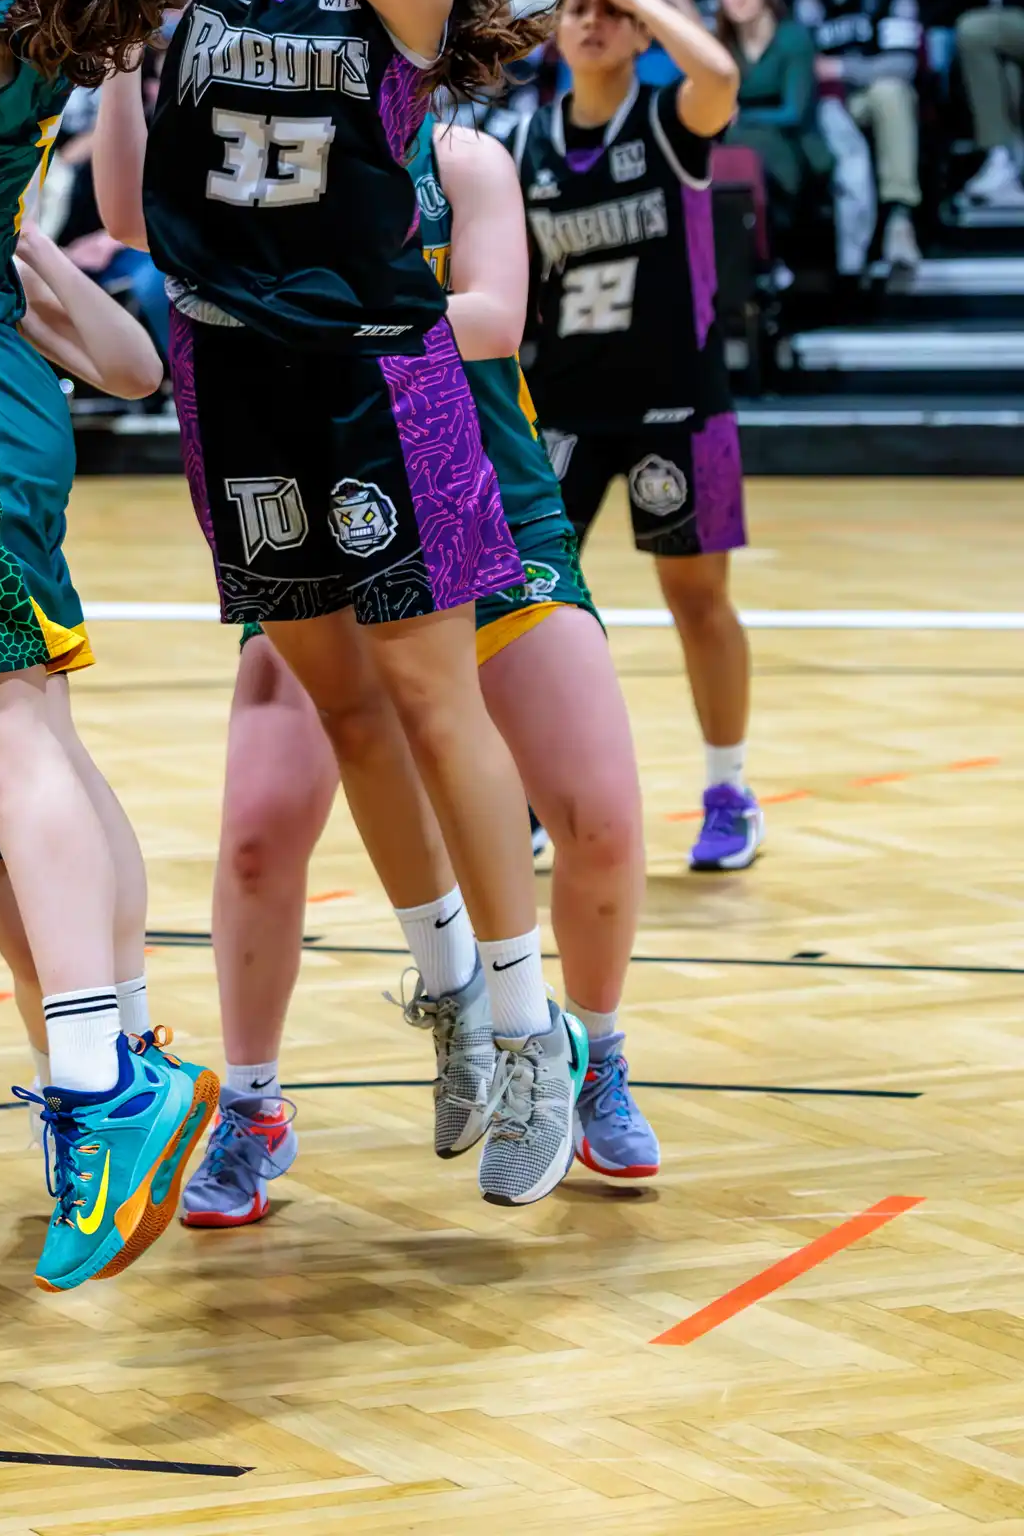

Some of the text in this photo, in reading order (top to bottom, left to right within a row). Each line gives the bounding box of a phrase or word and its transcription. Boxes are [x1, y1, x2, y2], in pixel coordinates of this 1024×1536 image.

[178, 4, 371, 107] ROBOTS
[205, 107, 336, 208] 33
[528, 187, 668, 282] ROBOTS
[557, 257, 639, 339] 22
[224, 475, 309, 566] TU
